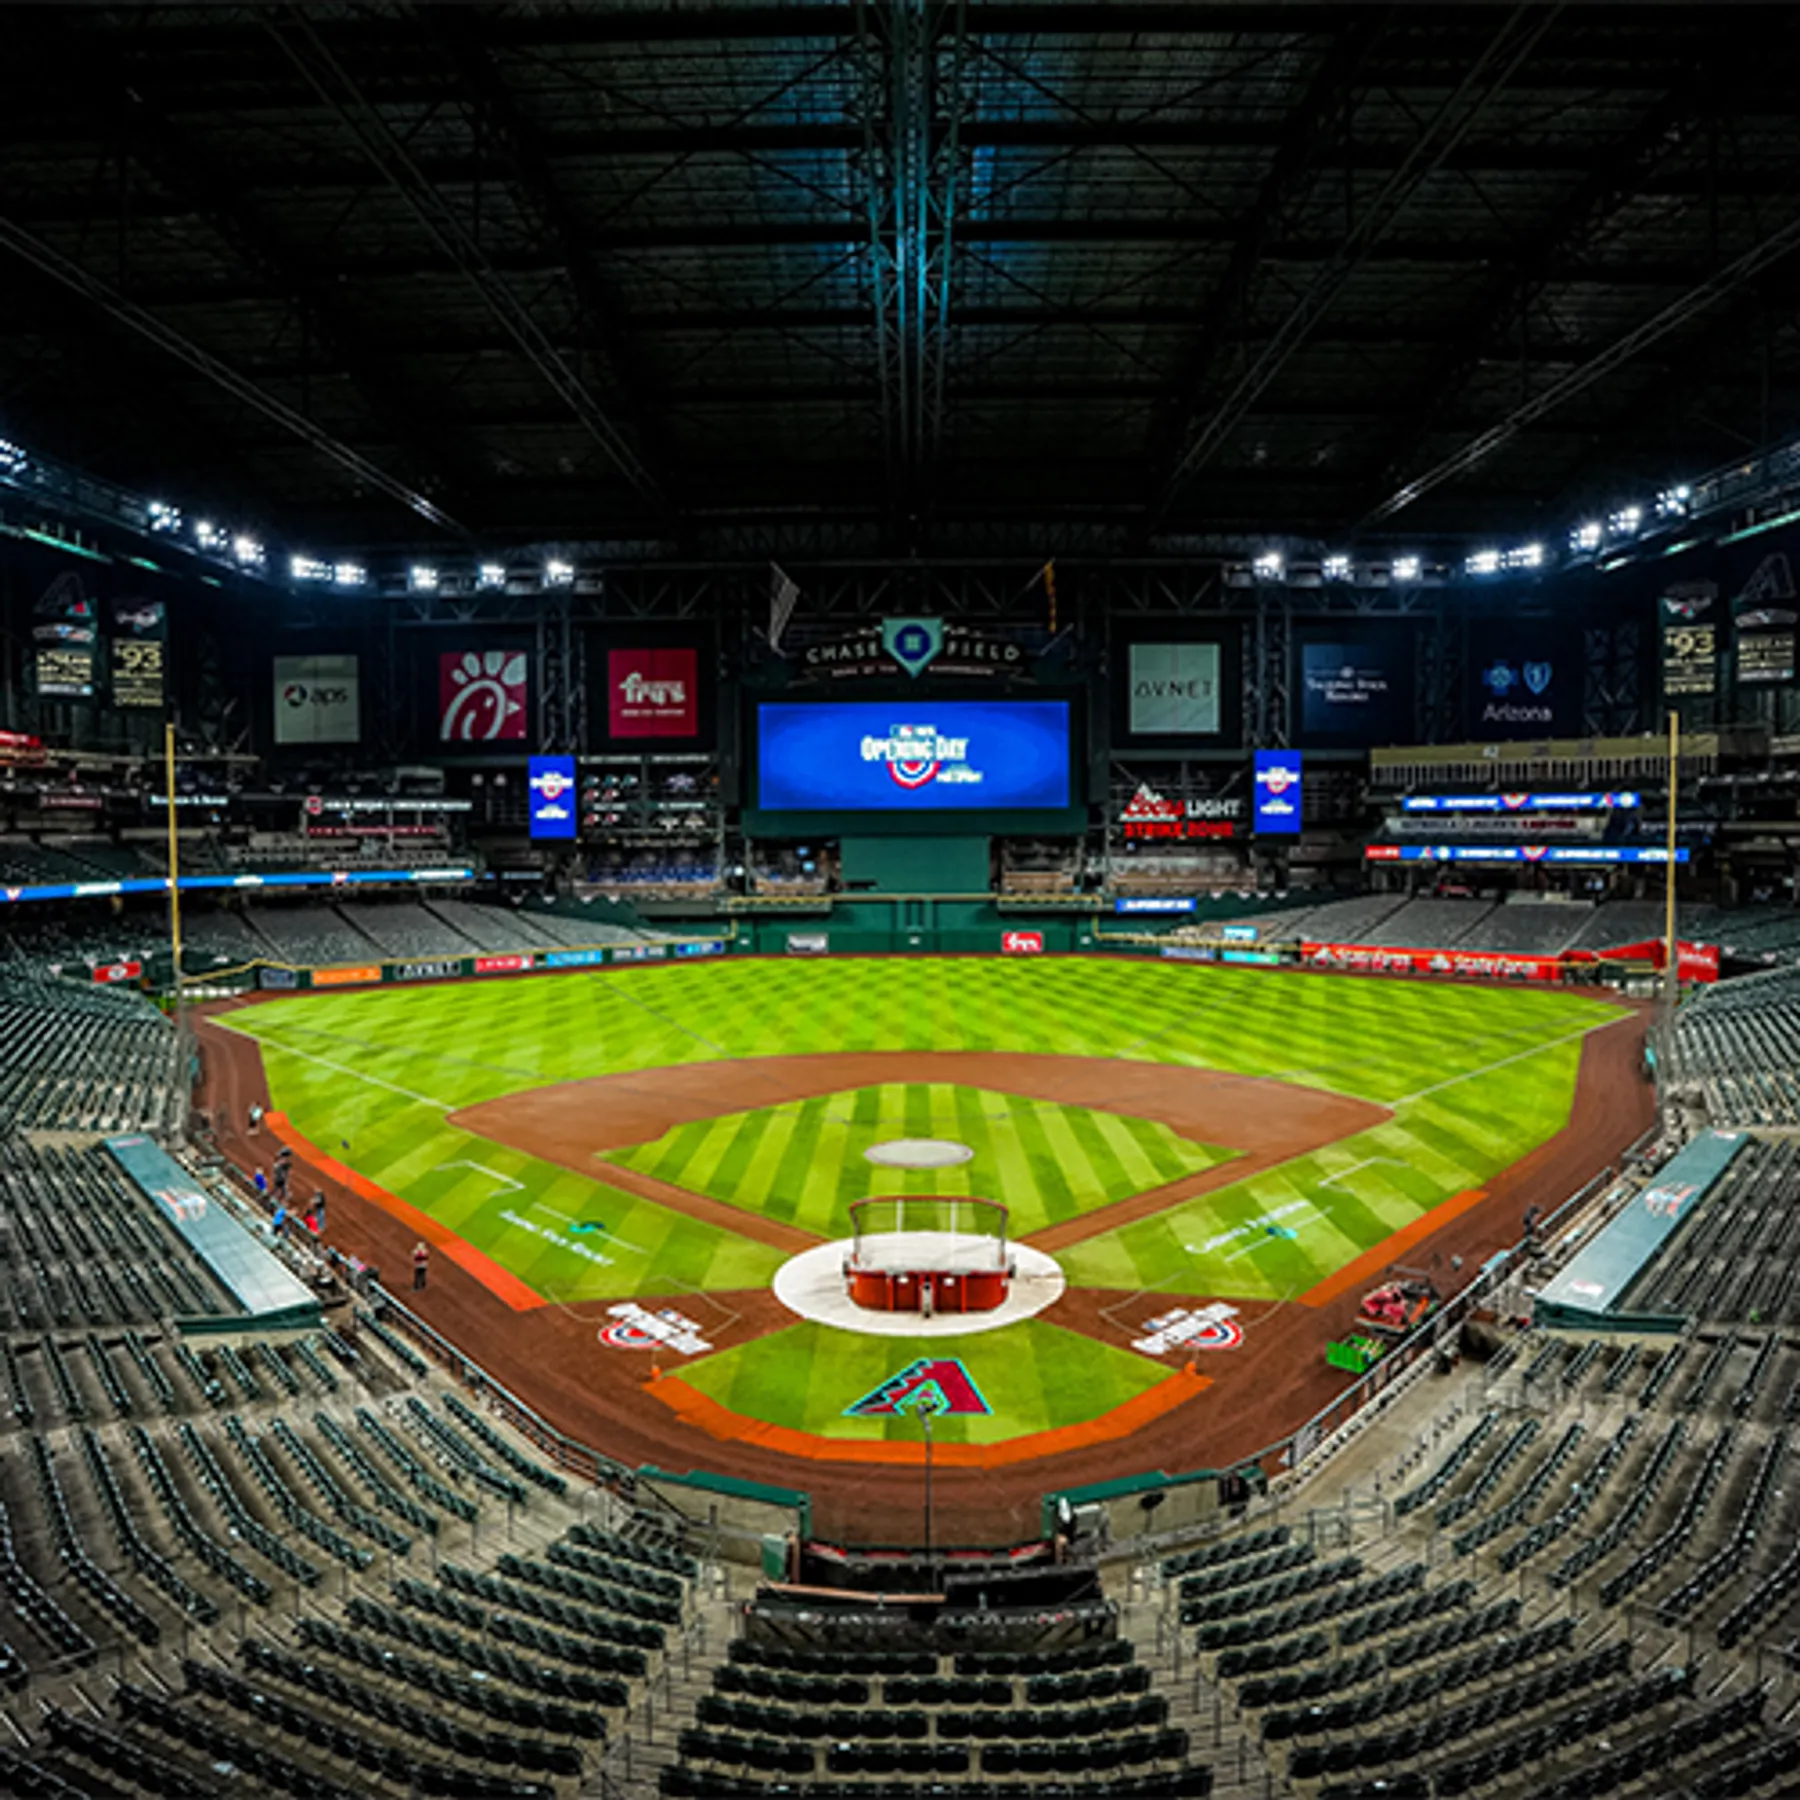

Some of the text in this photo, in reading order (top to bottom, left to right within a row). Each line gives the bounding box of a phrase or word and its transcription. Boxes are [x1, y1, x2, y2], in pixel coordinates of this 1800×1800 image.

[806, 641, 1020, 663] CHASE FIELD
[310, 686, 348, 707] aps
[1482, 703, 1553, 722] Arizona
[860, 735, 935, 761] OPENING
[1187, 800, 1241, 818] LIGHT
